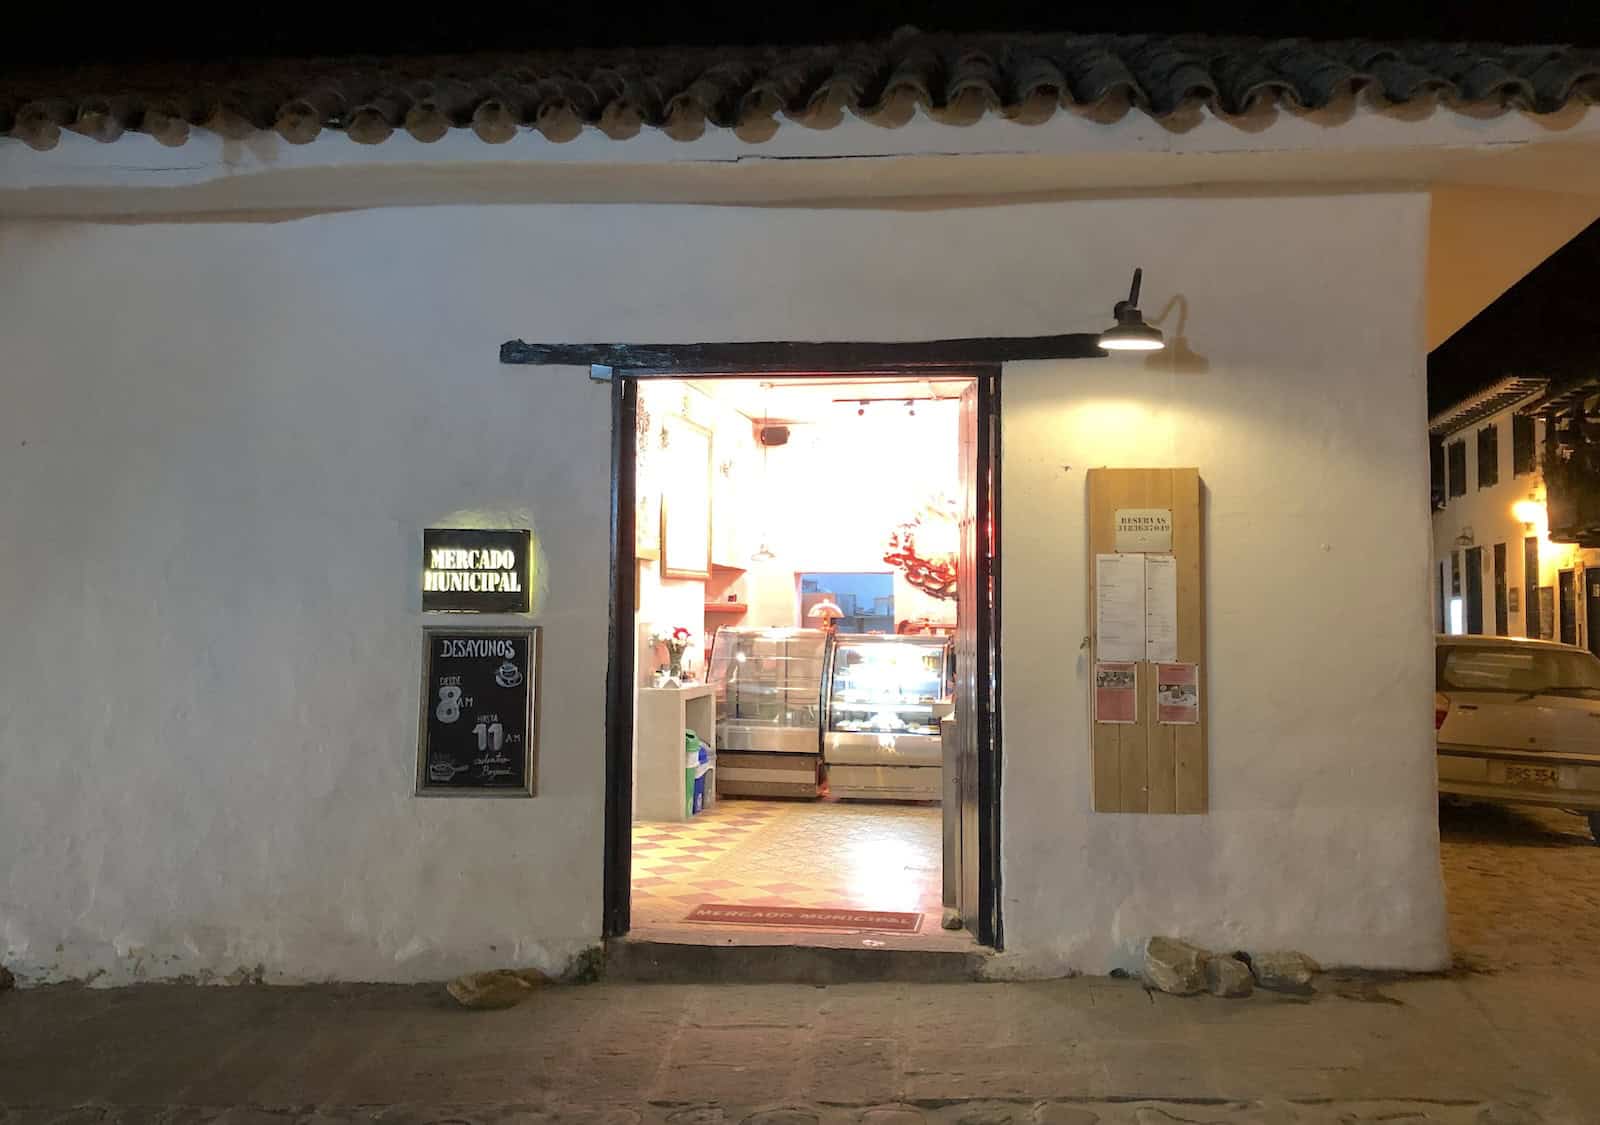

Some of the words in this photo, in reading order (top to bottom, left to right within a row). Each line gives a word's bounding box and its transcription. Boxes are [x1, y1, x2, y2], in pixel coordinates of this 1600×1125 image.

[430, 548, 515, 569] MERCADO
[424, 571, 521, 592] MUNICIPAL
[440, 640, 515, 659] DESAYUNOS
[436, 686, 461, 723] 8
[472, 723, 503, 750] 11
[505, 734, 520, 743] AM
[696, 909, 793, 919] MERCADO
[799, 912, 911, 925] MUNICIPAL
